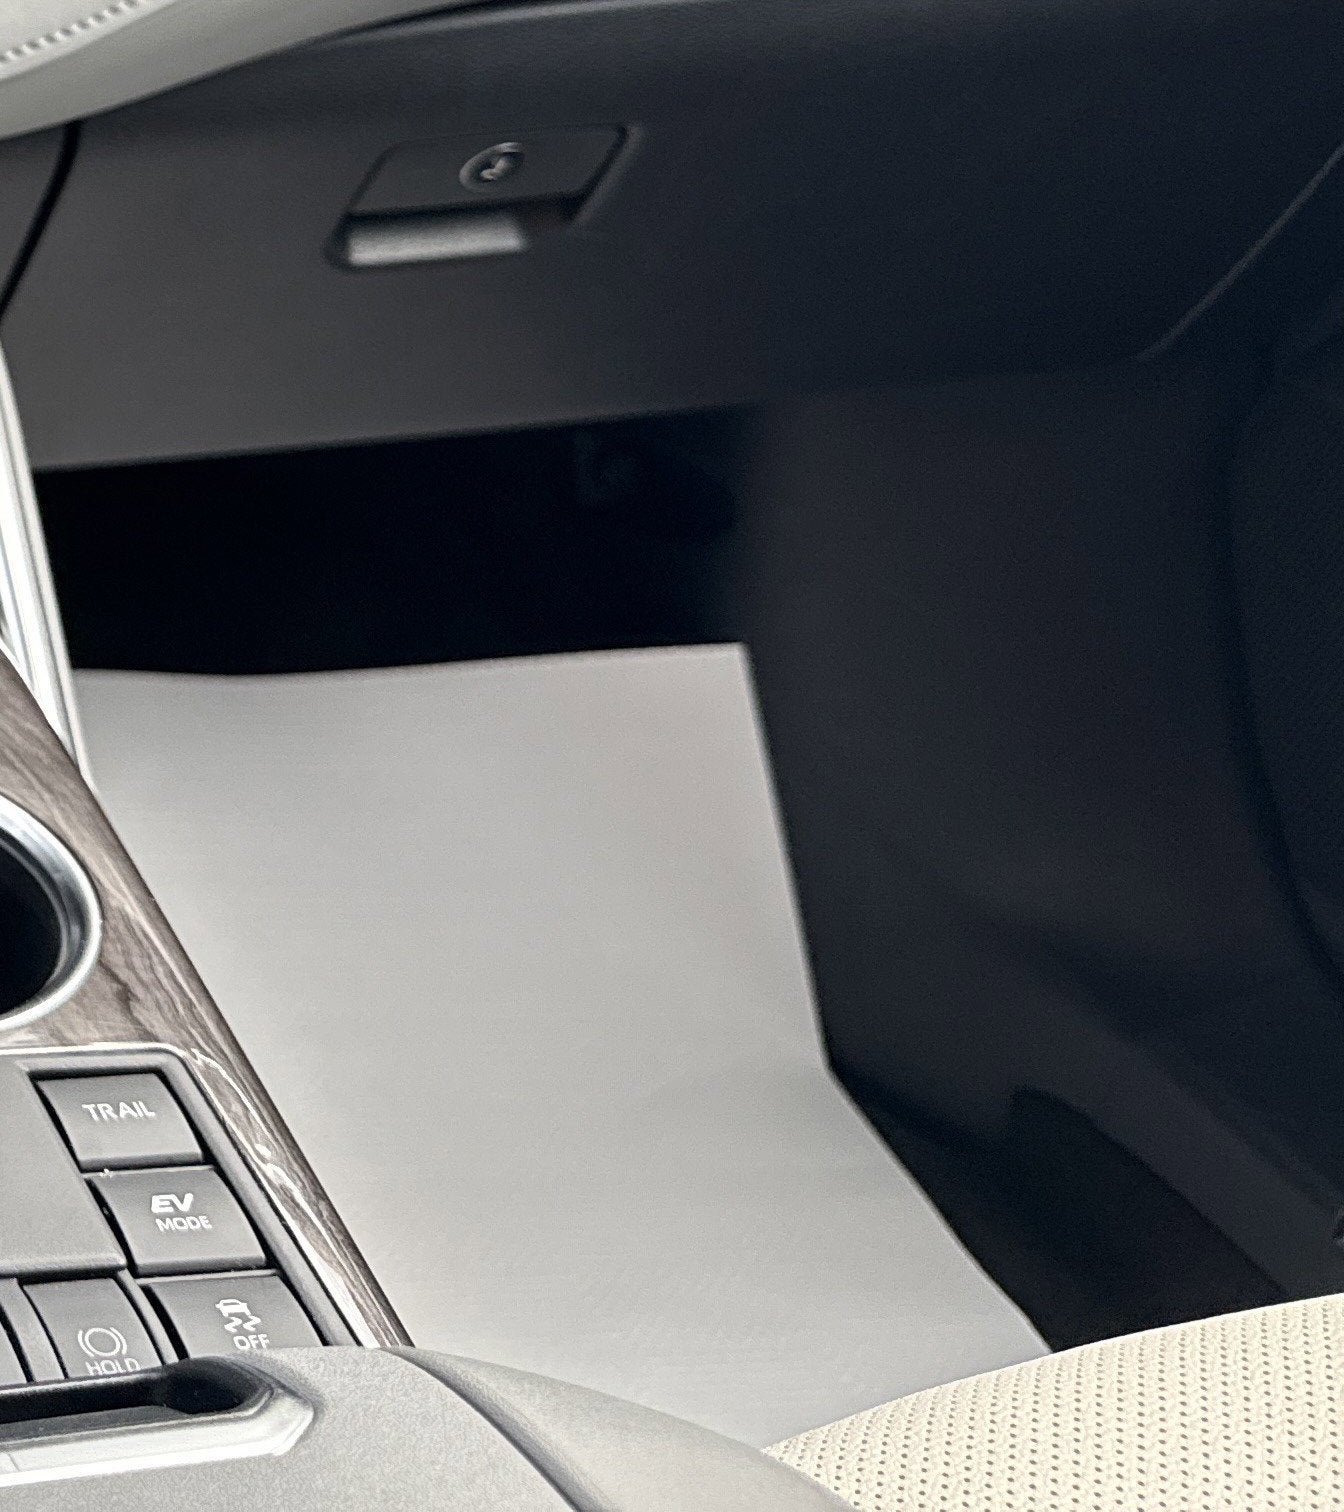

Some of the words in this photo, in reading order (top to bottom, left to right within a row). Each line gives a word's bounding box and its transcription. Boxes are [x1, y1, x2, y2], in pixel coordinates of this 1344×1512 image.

[82, 1101, 156, 1122] TRAIL
[150, 1193, 194, 1214] EV
[156, 1214, 212, 1233] MODE
[233, 1333, 272, 1352] OFF
[85, 1358, 141, 1376] HOLD
